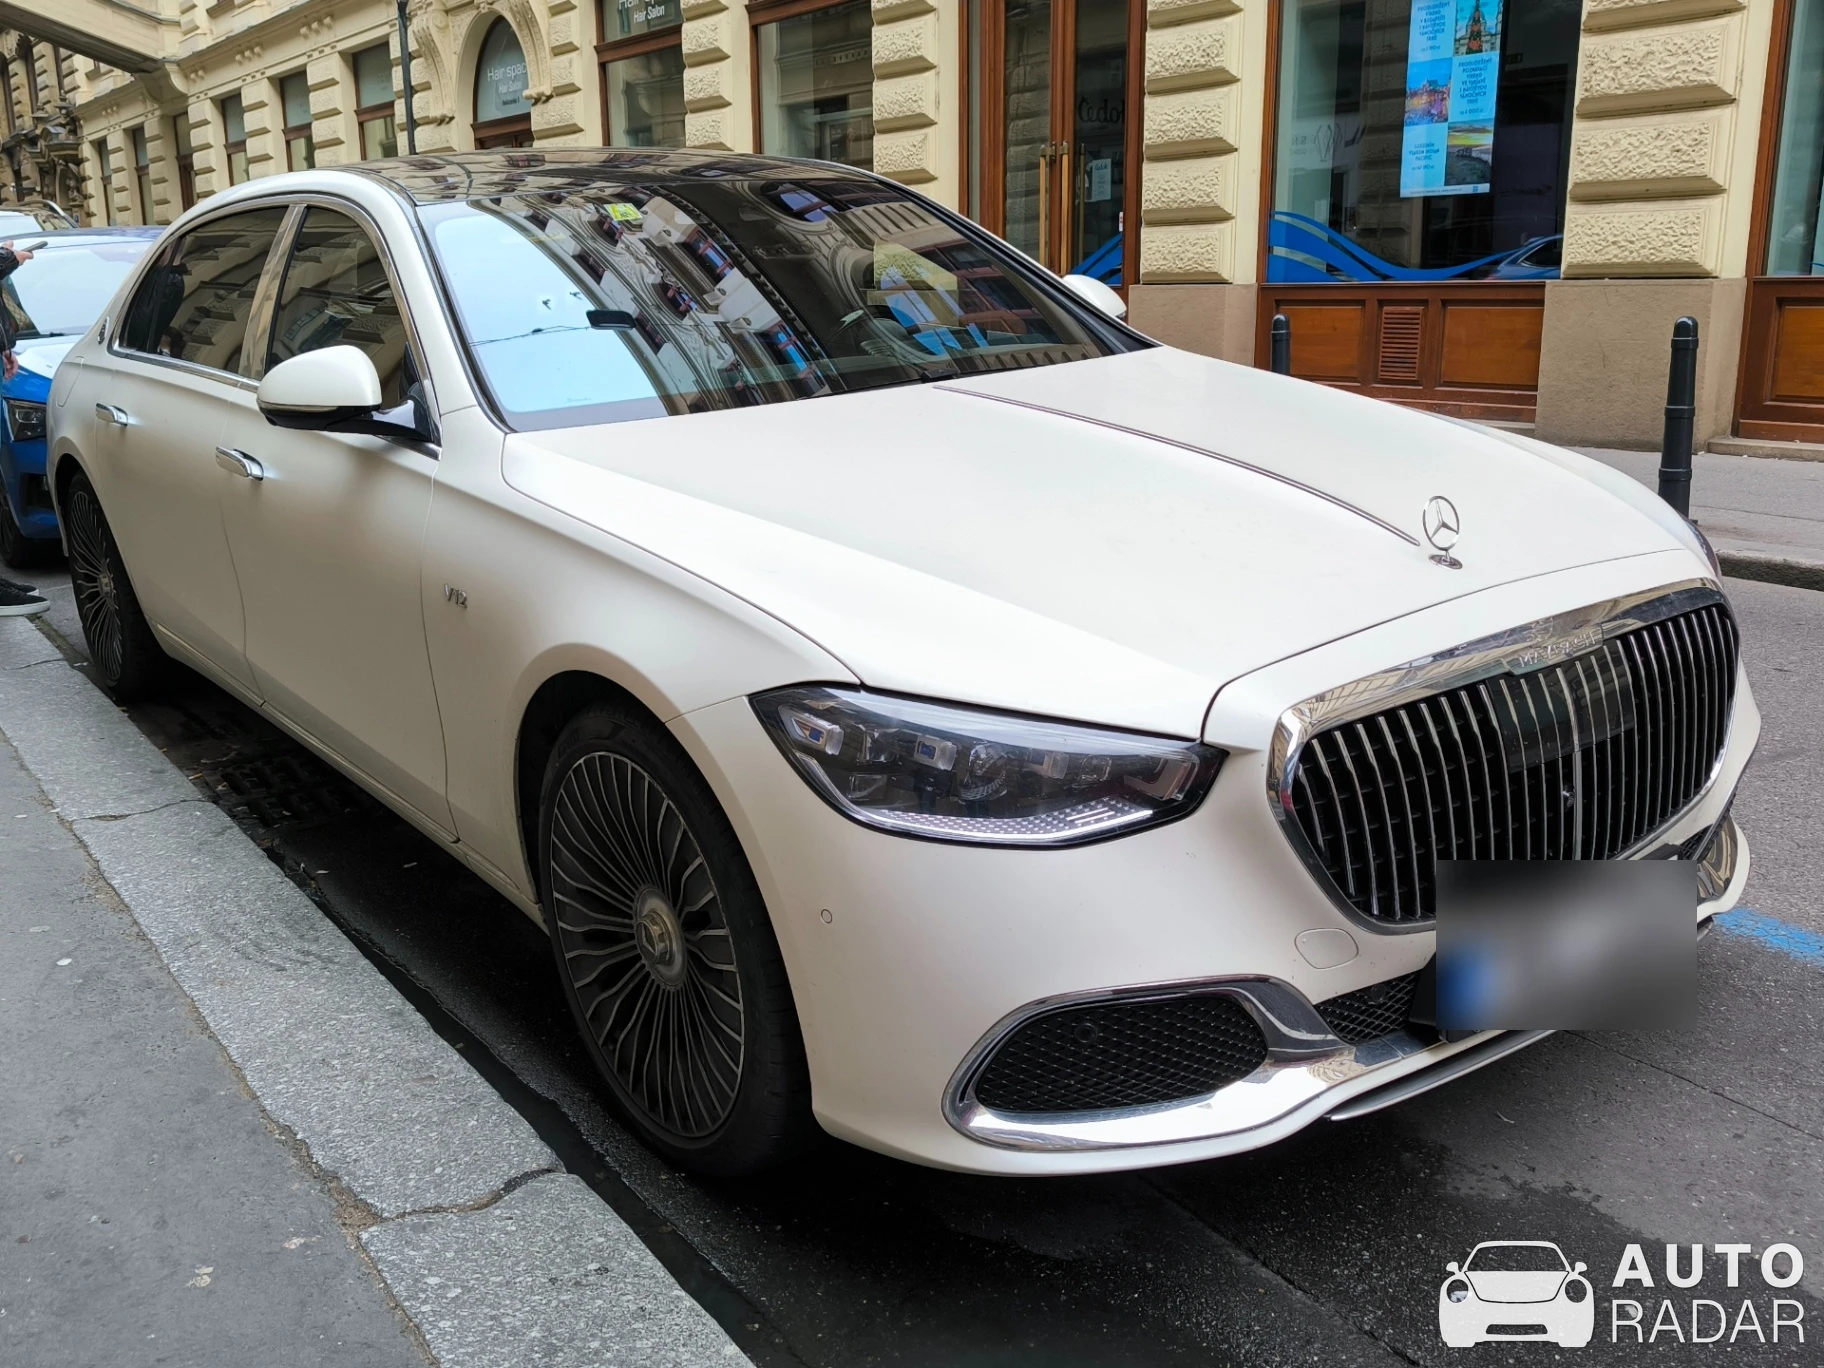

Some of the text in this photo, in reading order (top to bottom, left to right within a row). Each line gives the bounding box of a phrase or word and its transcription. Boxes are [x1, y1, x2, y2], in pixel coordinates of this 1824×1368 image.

[633, 5, 665, 24] Hair Salon
[487, 62, 527, 82] Hair spac
[444, 584, 467, 609] V12
